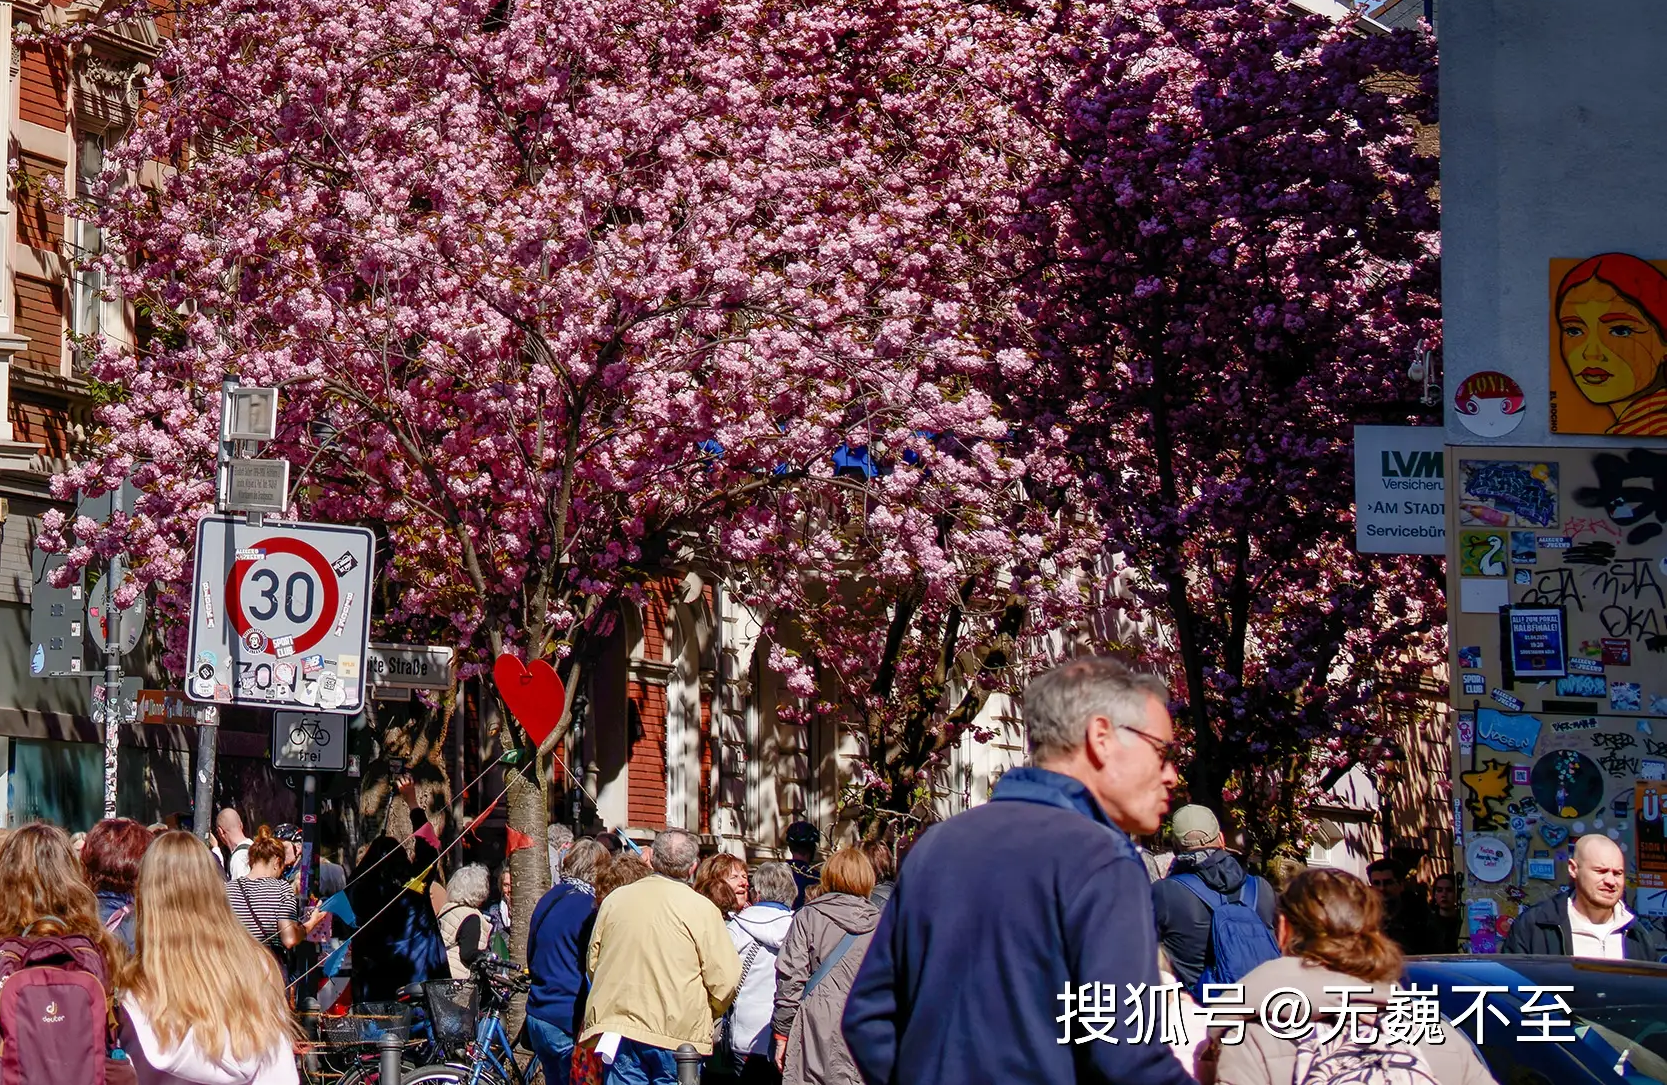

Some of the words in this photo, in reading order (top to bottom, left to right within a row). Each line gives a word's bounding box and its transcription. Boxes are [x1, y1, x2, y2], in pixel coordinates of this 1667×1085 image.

[1381, 451, 1444, 478] LVM
[1367, 524, 1445, 537] Servicebür
[248, 568, 315, 624] 30
[389, 657, 428, 676] Straße
[298, 749, 321, 762] frei
